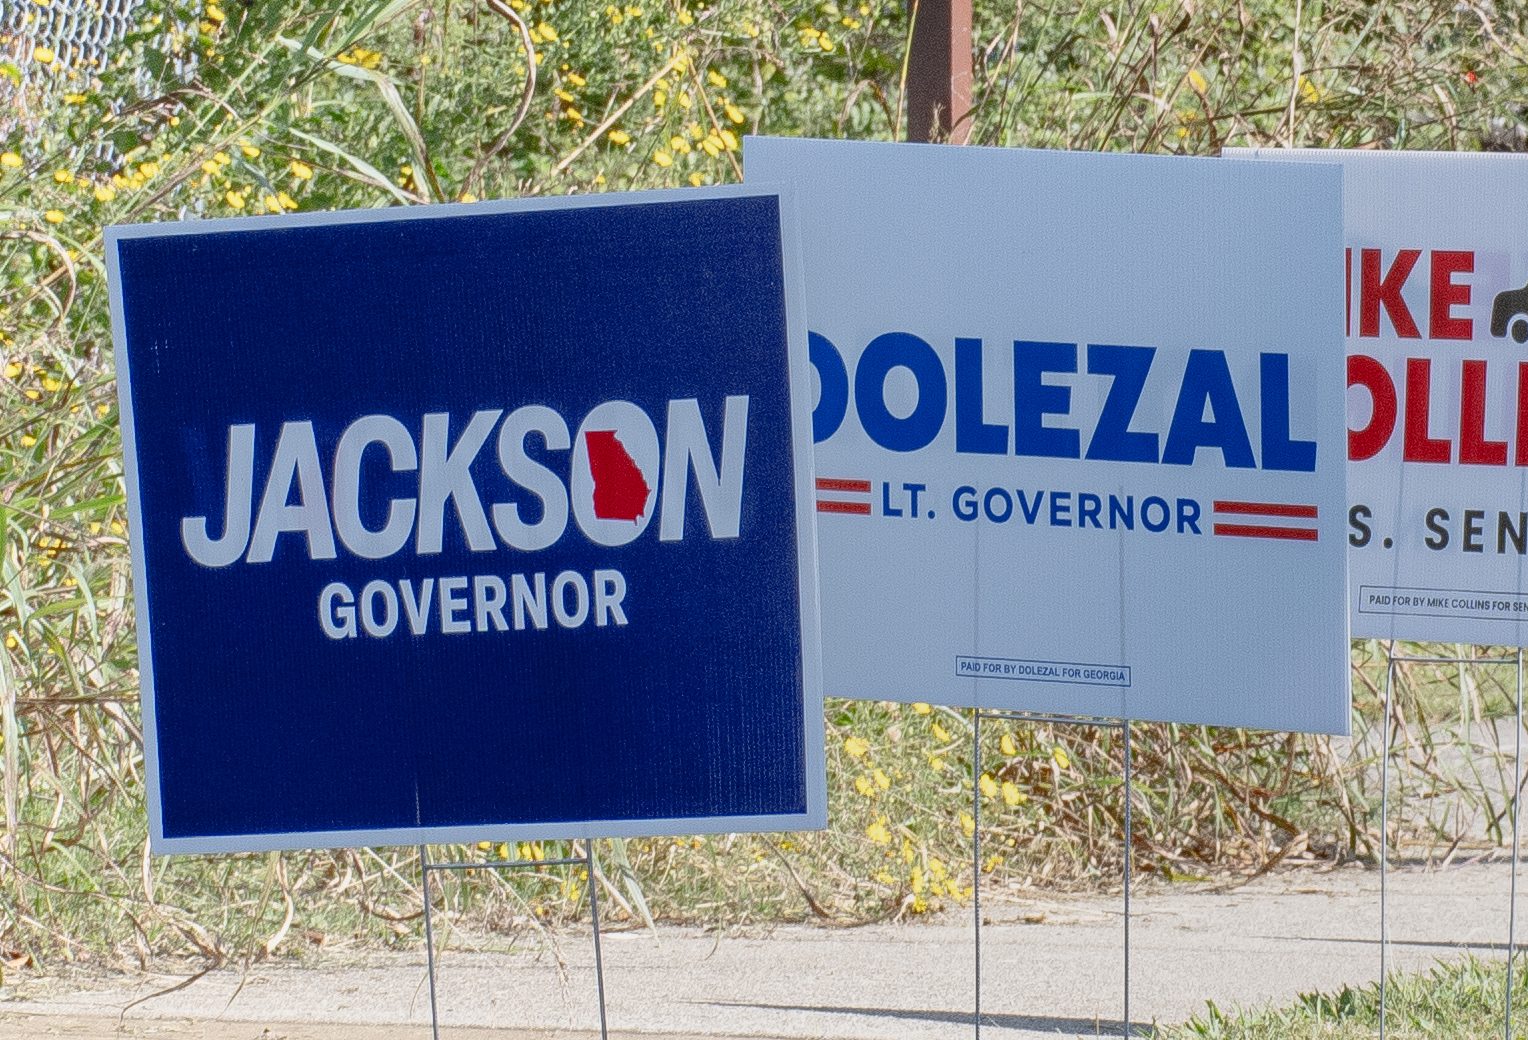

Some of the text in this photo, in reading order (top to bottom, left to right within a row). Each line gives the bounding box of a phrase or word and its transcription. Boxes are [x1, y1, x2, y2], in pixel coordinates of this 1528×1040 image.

[181, 395, 750, 568] JACKSON
[882, 481, 1202, 535] LT. GOVERNOR
[319, 570, 630, 640] GOVERNOR
[1369, 594, 1391, 606] PAID
[1392, 596, 1410, 607] FOR
[1413, 598, 1425, 607] BY
[1426, 598, 1449, 609] MIKE
[1451, 599, 1491, 611] COLLINS
[1492, 601, 1511, 612] FOR
[960, 661, 1126, 682] PAID FOR BY DOLEZAL FOR GEORGIA
